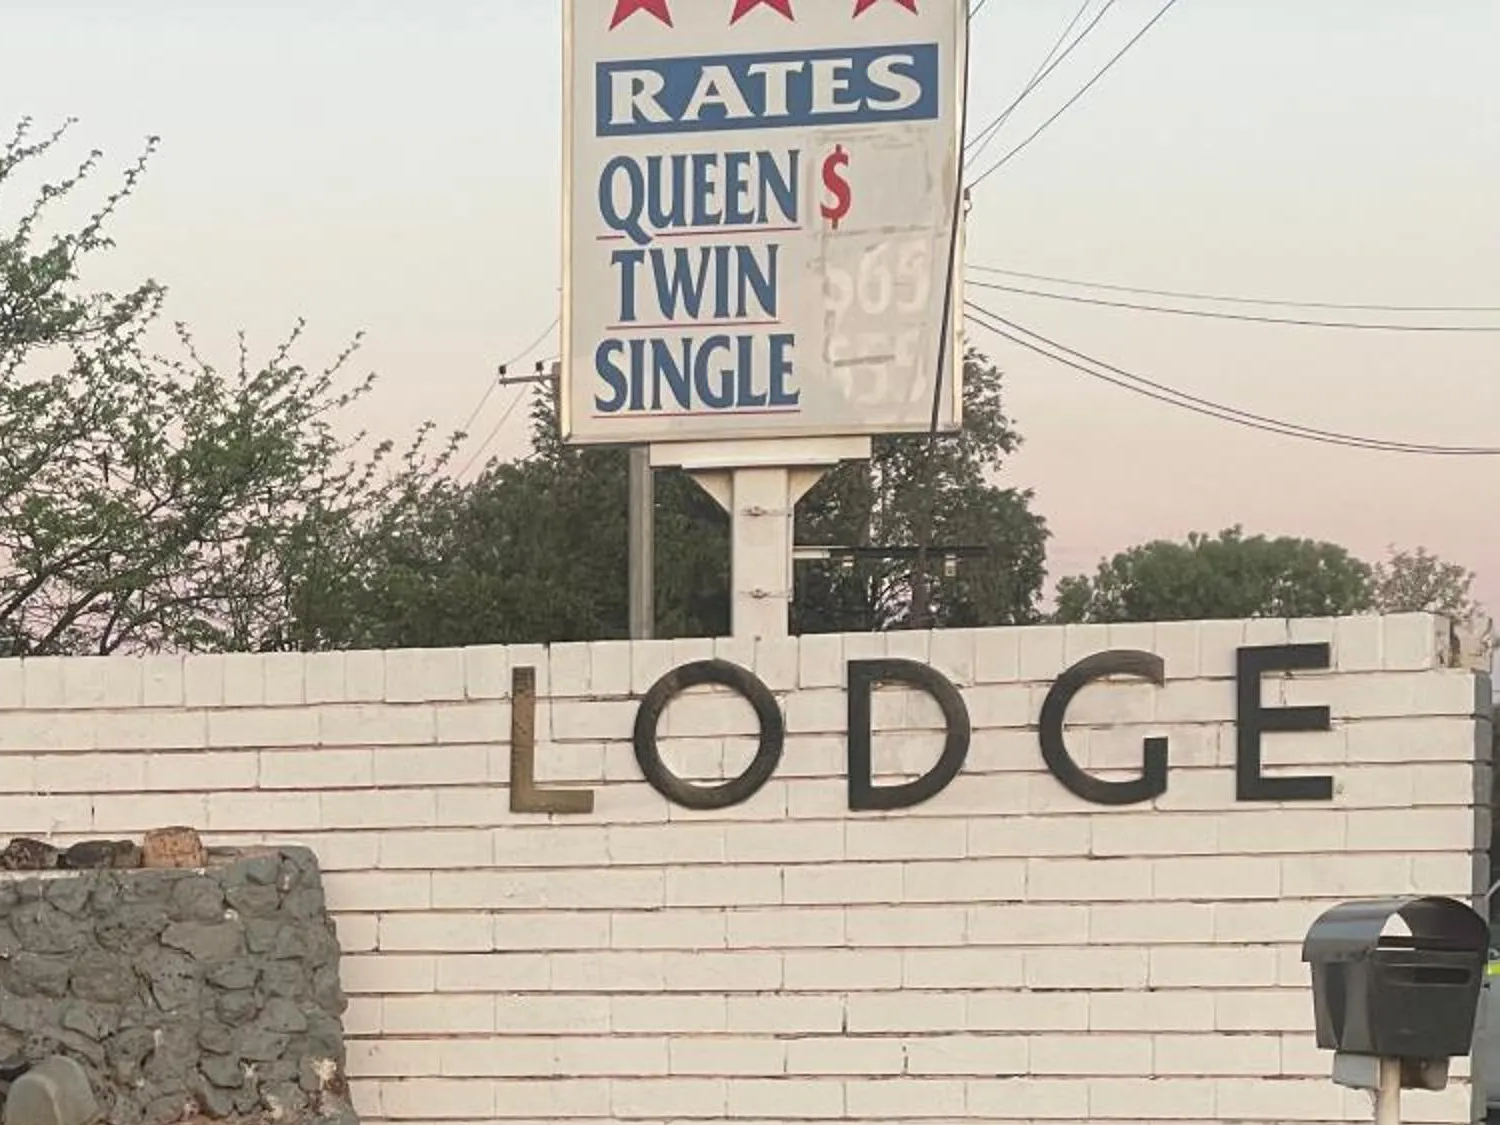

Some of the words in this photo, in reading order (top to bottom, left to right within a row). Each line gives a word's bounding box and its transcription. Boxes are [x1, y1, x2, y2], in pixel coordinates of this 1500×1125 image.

[608, 54, 923, 126] RATES
[599, 149, 801, 245] QUEEN
[819, 144, 853, 230] $
[611, 244, 780, 322] TWIN
[594, 333, 801, 412] SINGLE
[509, 641, 1335, 814] LODGE
